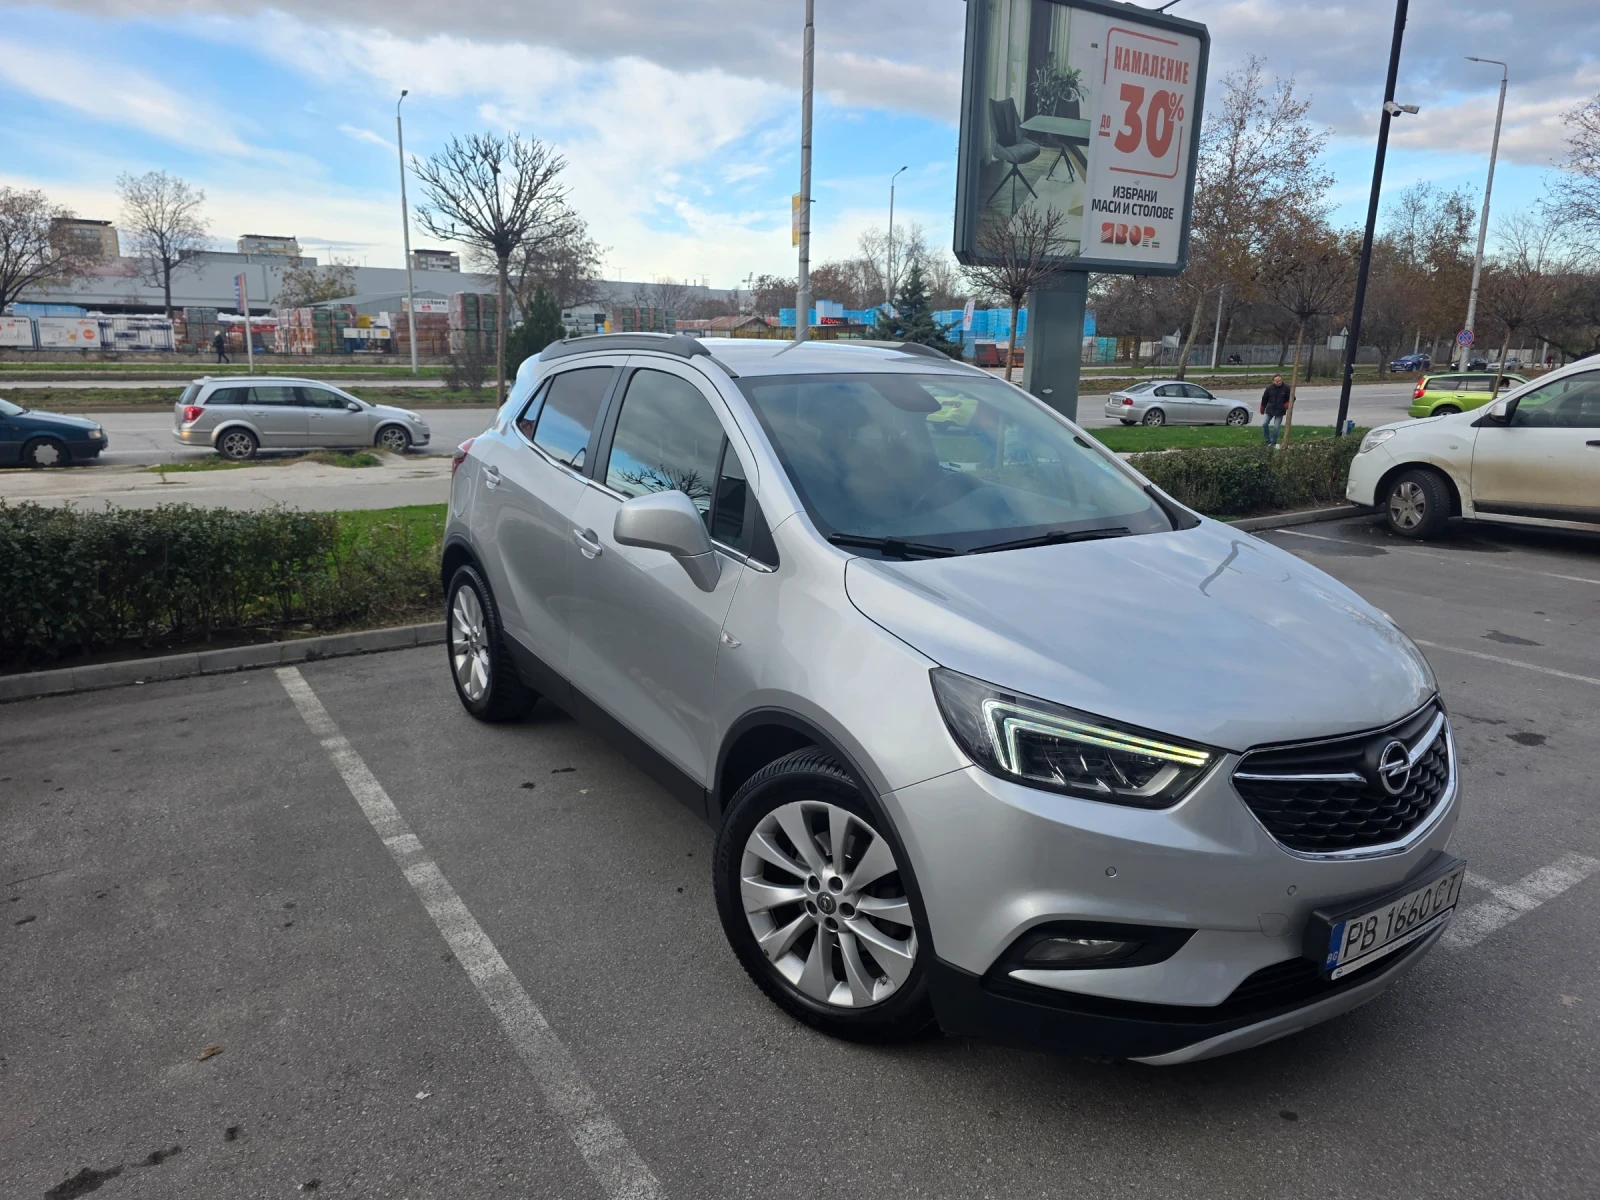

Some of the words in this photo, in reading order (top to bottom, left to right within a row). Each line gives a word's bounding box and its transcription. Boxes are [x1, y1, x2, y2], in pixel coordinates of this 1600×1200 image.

[1114, 45, 1189, 84] НАМАЛЕНИЕ
[1100, 114, 1111, 130] ДО
[1114, 83, 1184, 158] 30%
[1091, 199, 1121, 214] МАСИ
[1122, 202, 1130, 215] И
[1131, 203, 1174, 220] СТОЛОВЕ
[1112, 185, 1158, 203] ИЗБРАНИ
[1100, 222, 1156, 247] ЯВОР
[1327, 951, 1339, 964] BG
[1343, 916, 1378, 958] PB
